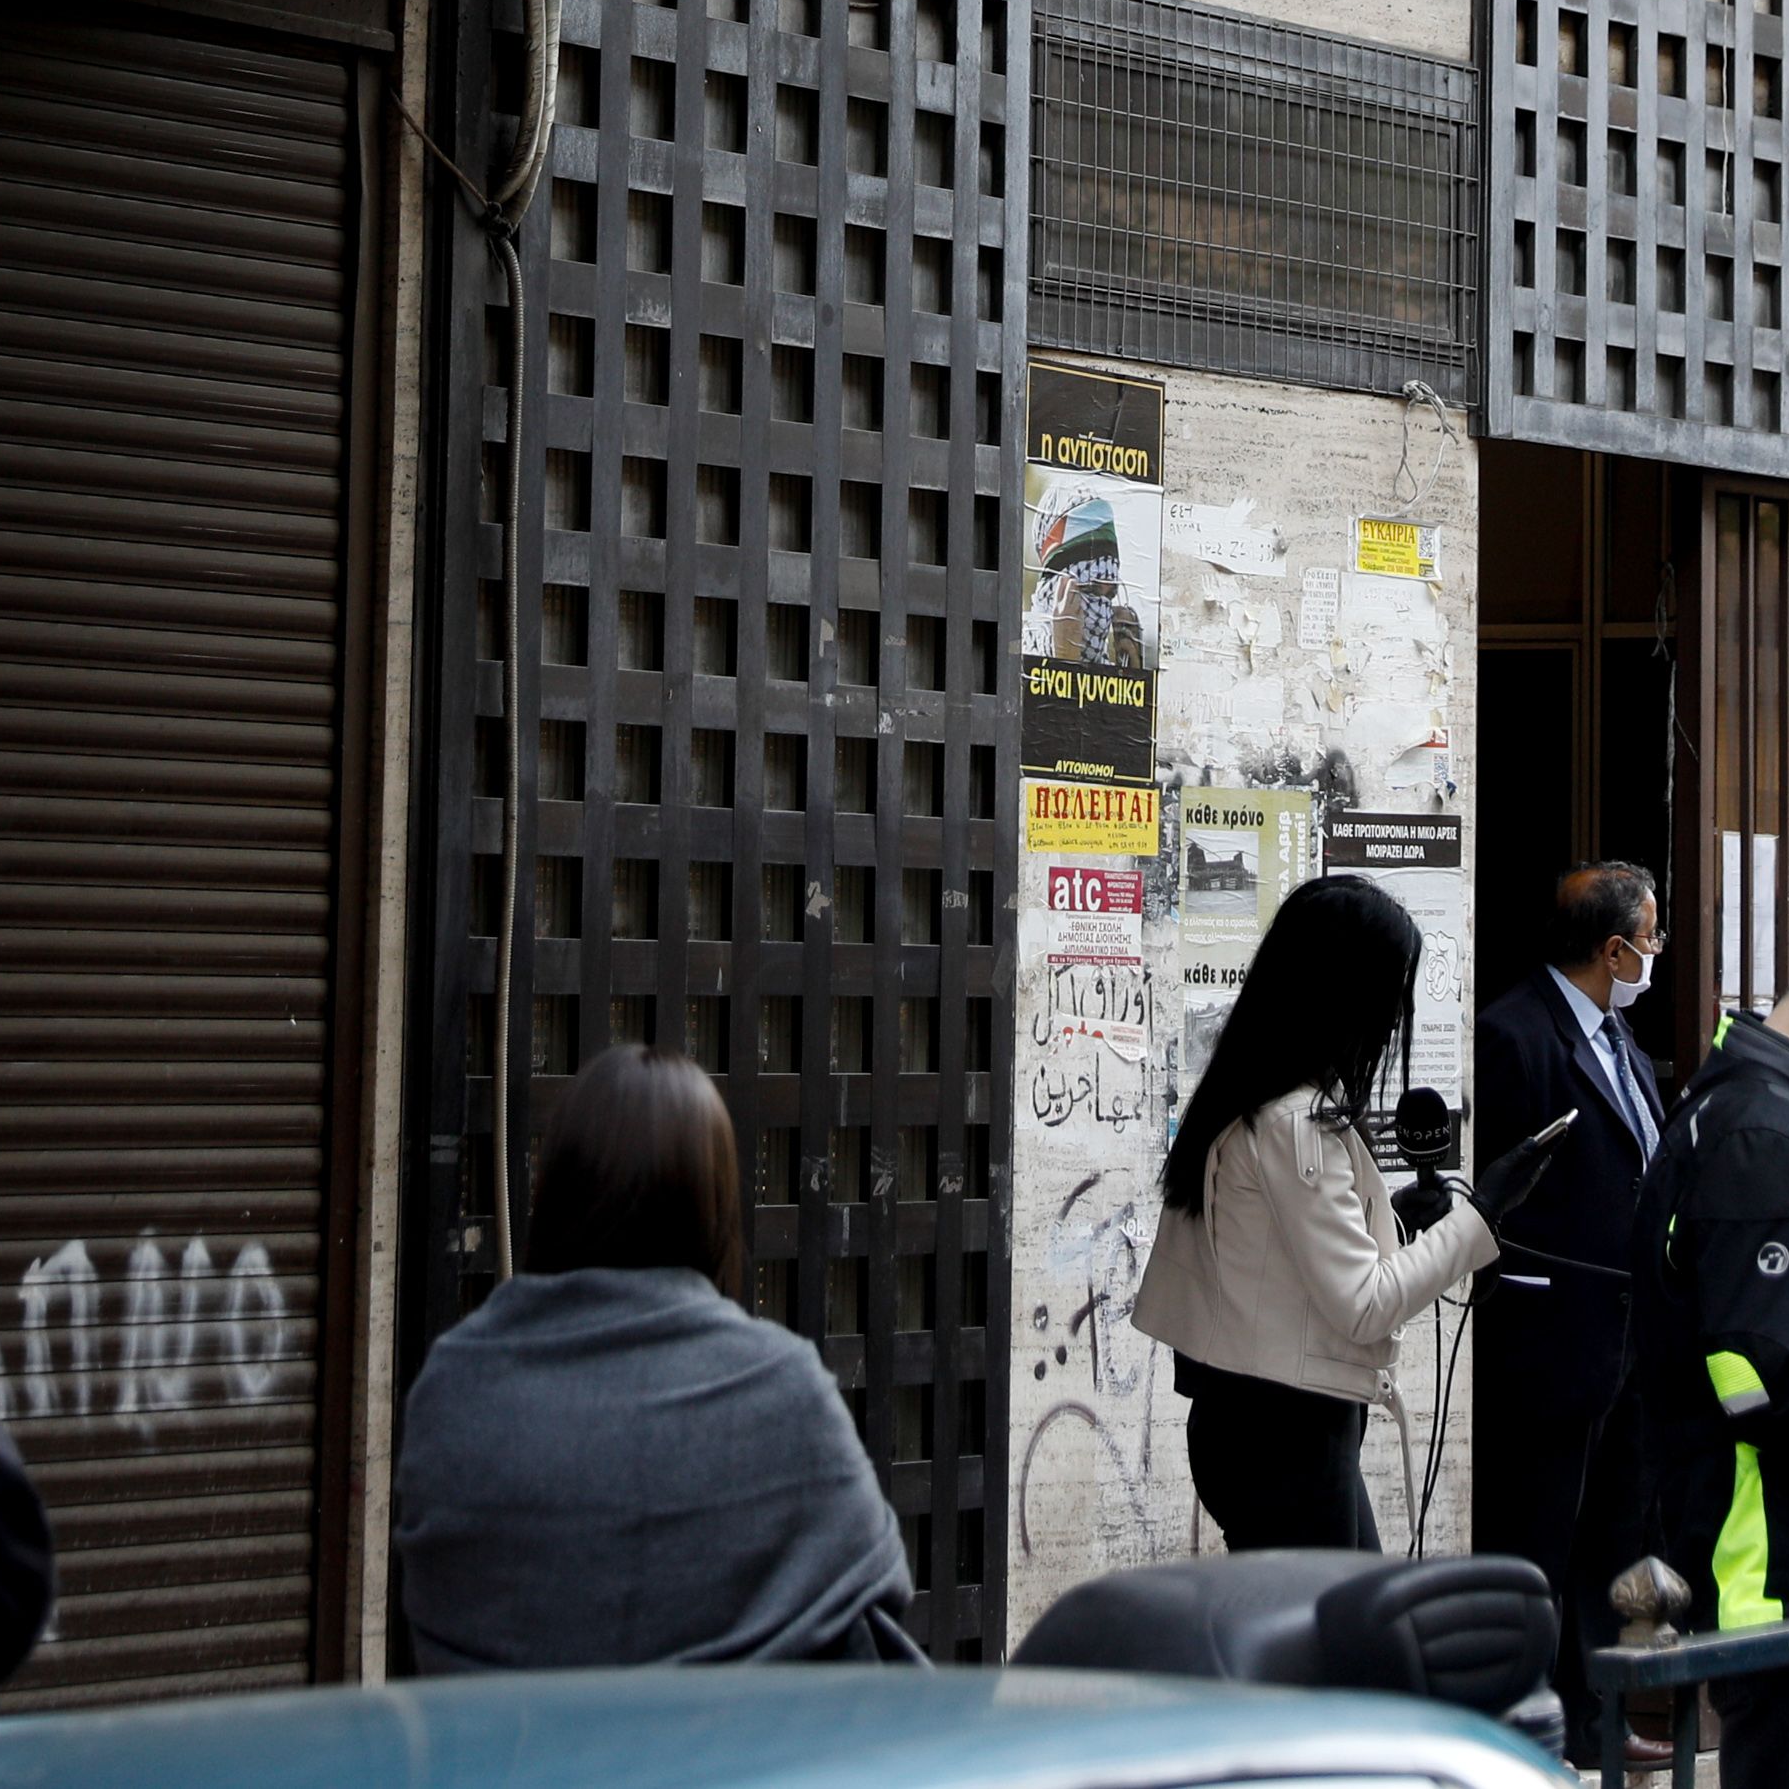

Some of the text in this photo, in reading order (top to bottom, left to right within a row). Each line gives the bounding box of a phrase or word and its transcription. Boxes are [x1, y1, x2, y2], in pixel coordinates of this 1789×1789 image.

[1041, 431, 1148, 477] η αντίσταση
[1362, 520, 1415, 544] ΕΥΚΑΙΡΙΑ
[1030, 658, 1072, 699] είναι
[1055, 760, 1115, 778] ΑΥΤΟΝΟΜΟΙ
[1035, 785, 1154, 824] ΠΩΛΕΙΤΑΙ
[1186, 803, 1265, 830] κάθε χρόνο
[1332, 823, 1457, 840] ΚΑΘΕ ΠΡΩΤΟΧΡΟΝΙΑ Η ΜΚΟ ΑΡΣΙΣ
[1366, 844, 1425, 859] ΜΟΙΡΑΖΕΙ ΔΩΡΑ
[1053, 869, 1102, 911] atc
[1057, 931, 1131, 945] ΔΗΜΟΣΙΑΣ ΔΙΟΙΚΗΣΗΣ
[1098, 922, 1121, 933] ΣΧΟΛΗ
[1109, 946, 1128, 956] ΣΩΜΑ
[1184, 962, 1248, 989] κάθε χρό
